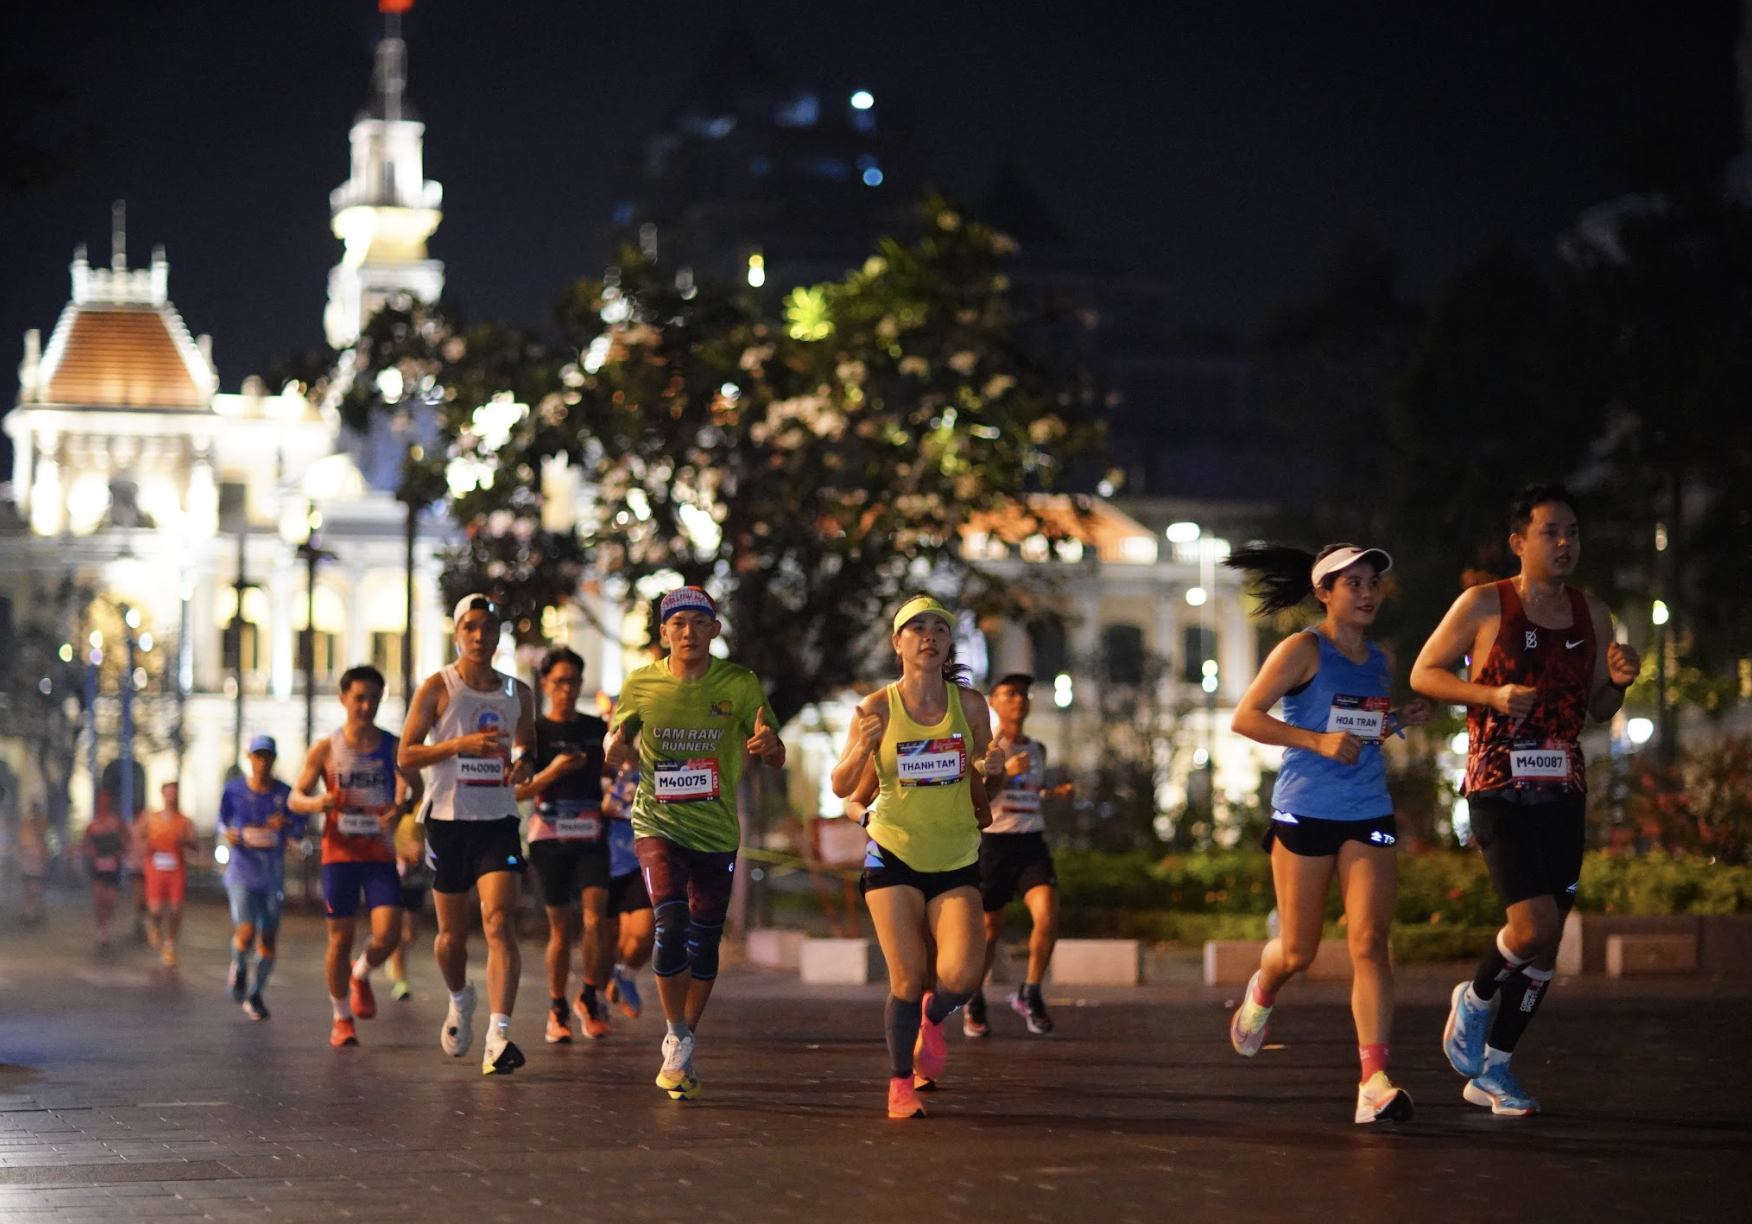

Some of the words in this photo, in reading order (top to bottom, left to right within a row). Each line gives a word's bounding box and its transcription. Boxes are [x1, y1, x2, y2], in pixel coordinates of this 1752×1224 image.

[1335, 716, 1354, 725] HOA
[1356, 717, 1377, 727] TRAN
[653, 727, 685, 740] CAM
[662, 741, 716, 752] RUNNERS
[901, 761, 934, 772] THANH
[936, 759, 956, 768] TAM
[1516, 756, 1563, 768] M40087
[659, 775, 707, 788] M40075
